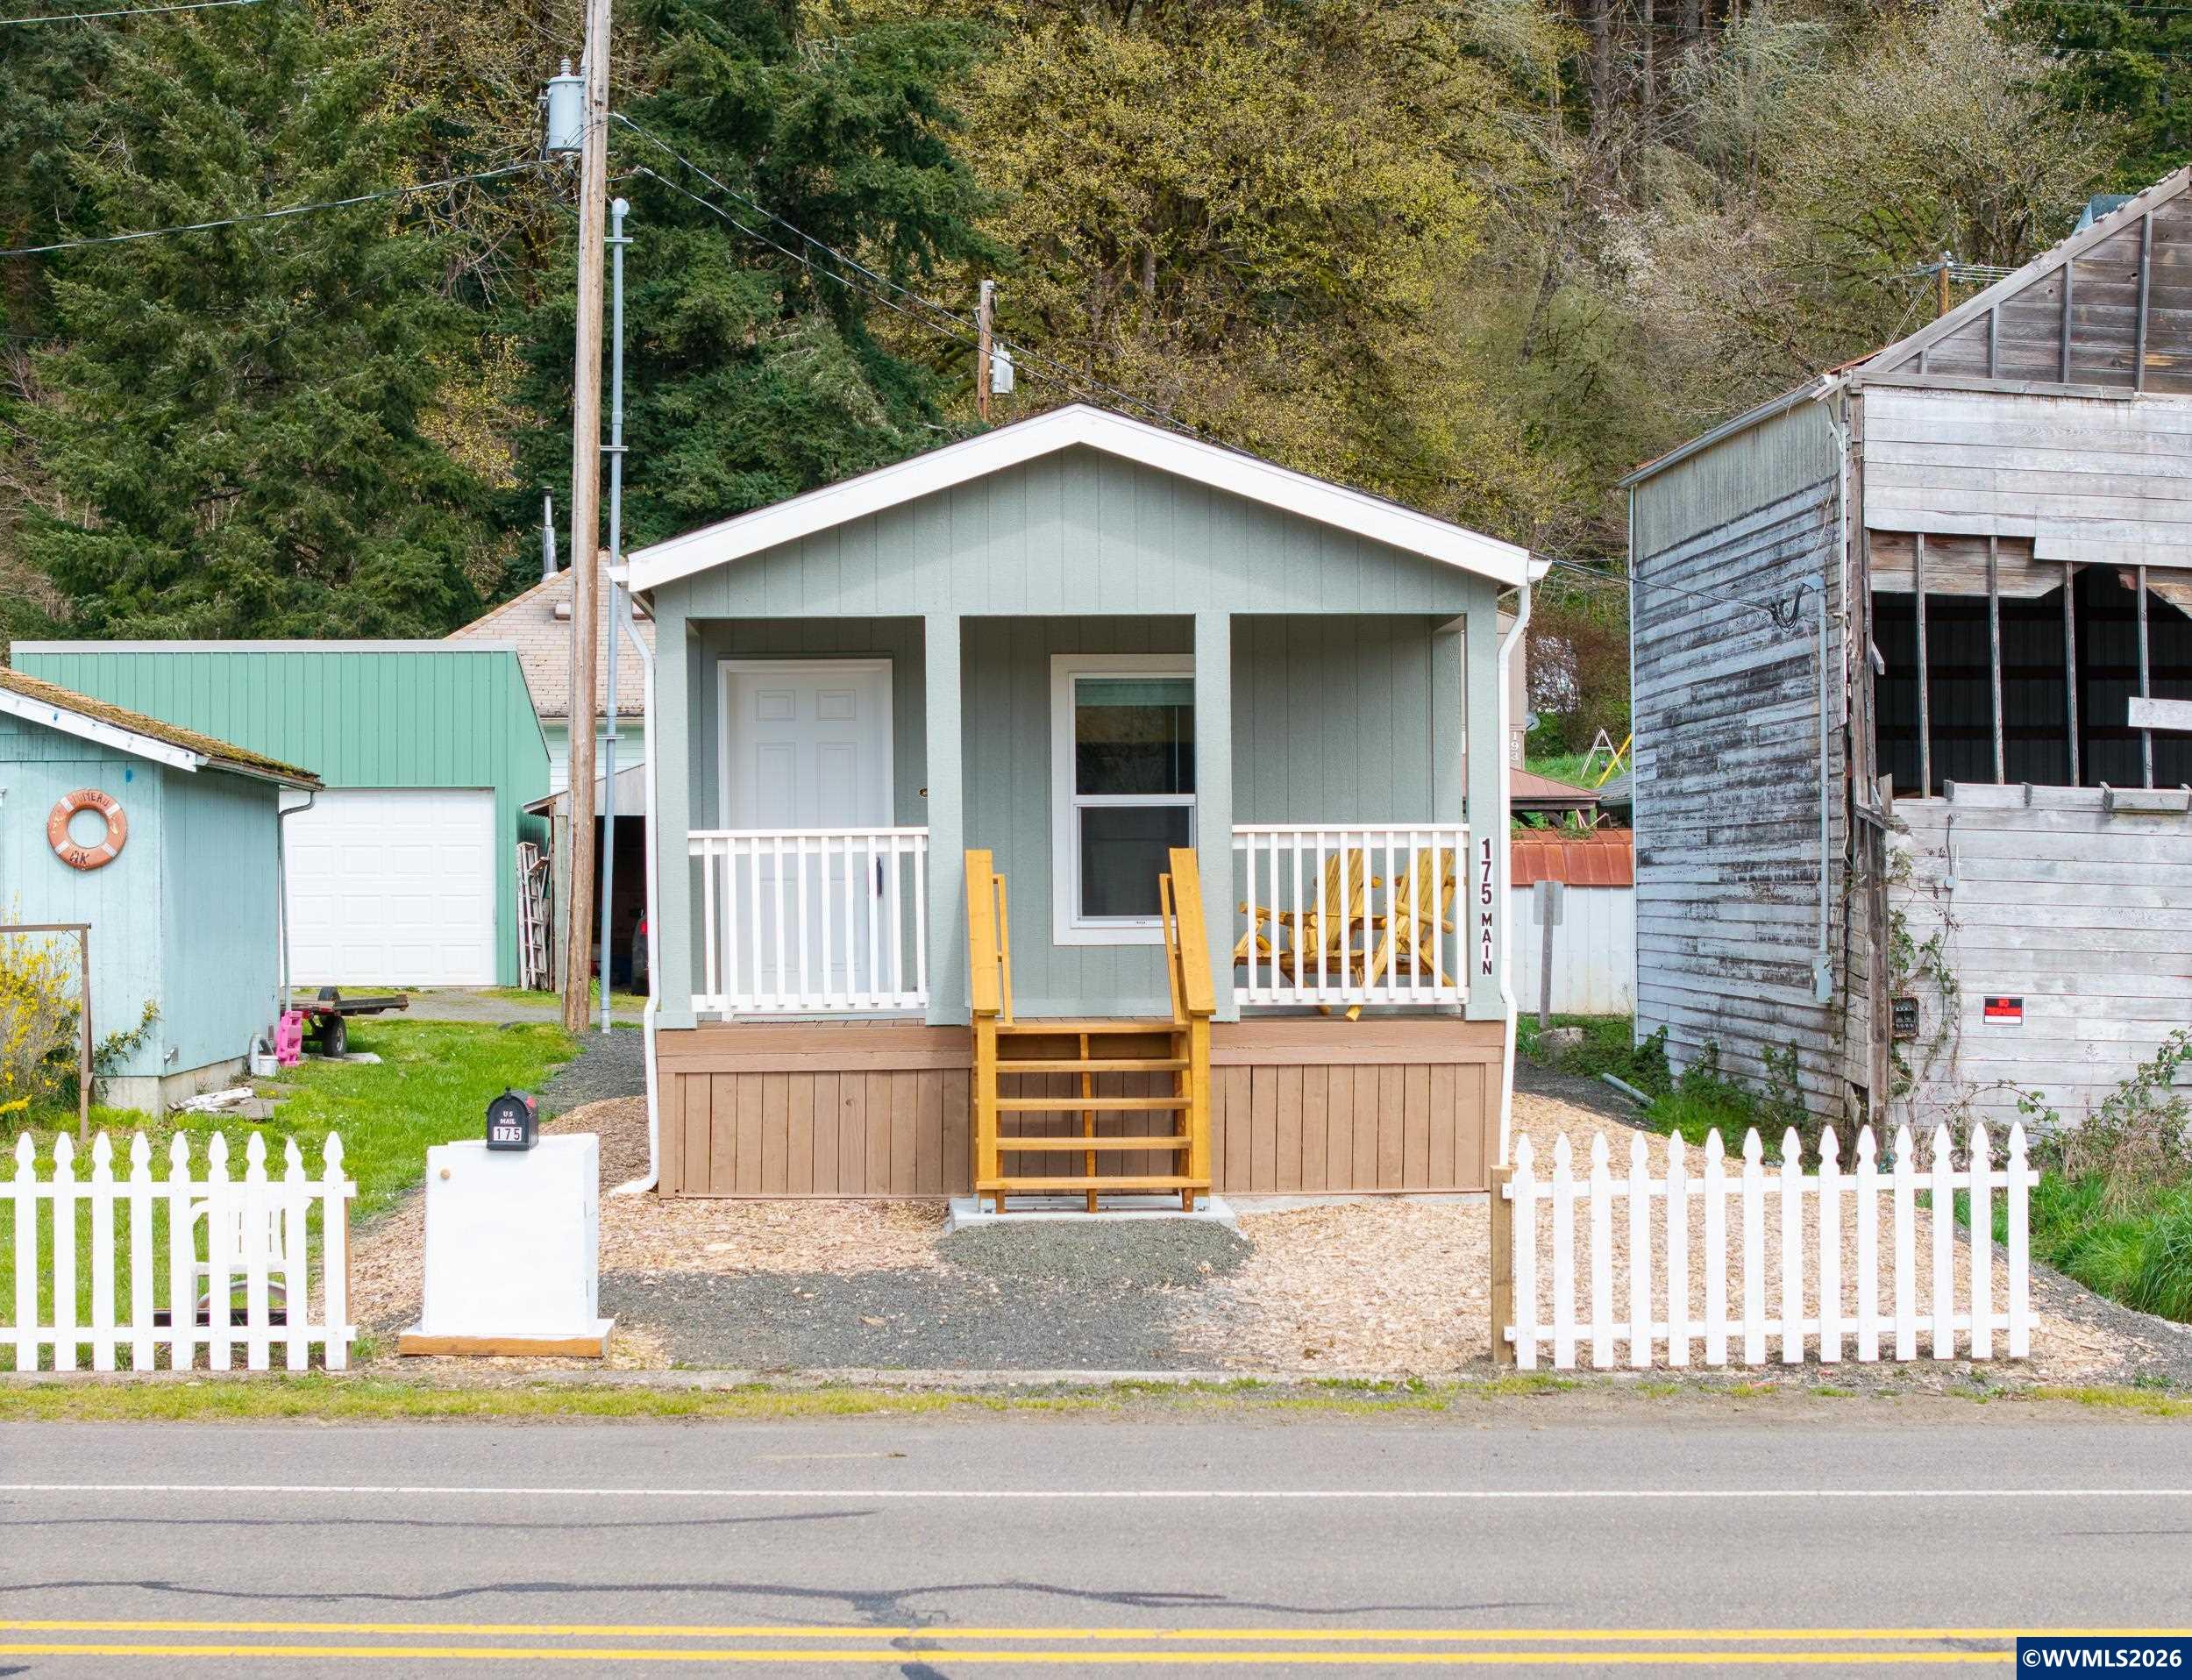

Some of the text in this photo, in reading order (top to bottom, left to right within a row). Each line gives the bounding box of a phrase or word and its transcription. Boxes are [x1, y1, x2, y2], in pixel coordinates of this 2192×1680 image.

[1481, 838, 1492, 975] 175 MAIN
[497, 1128, 520, 1141] 175
